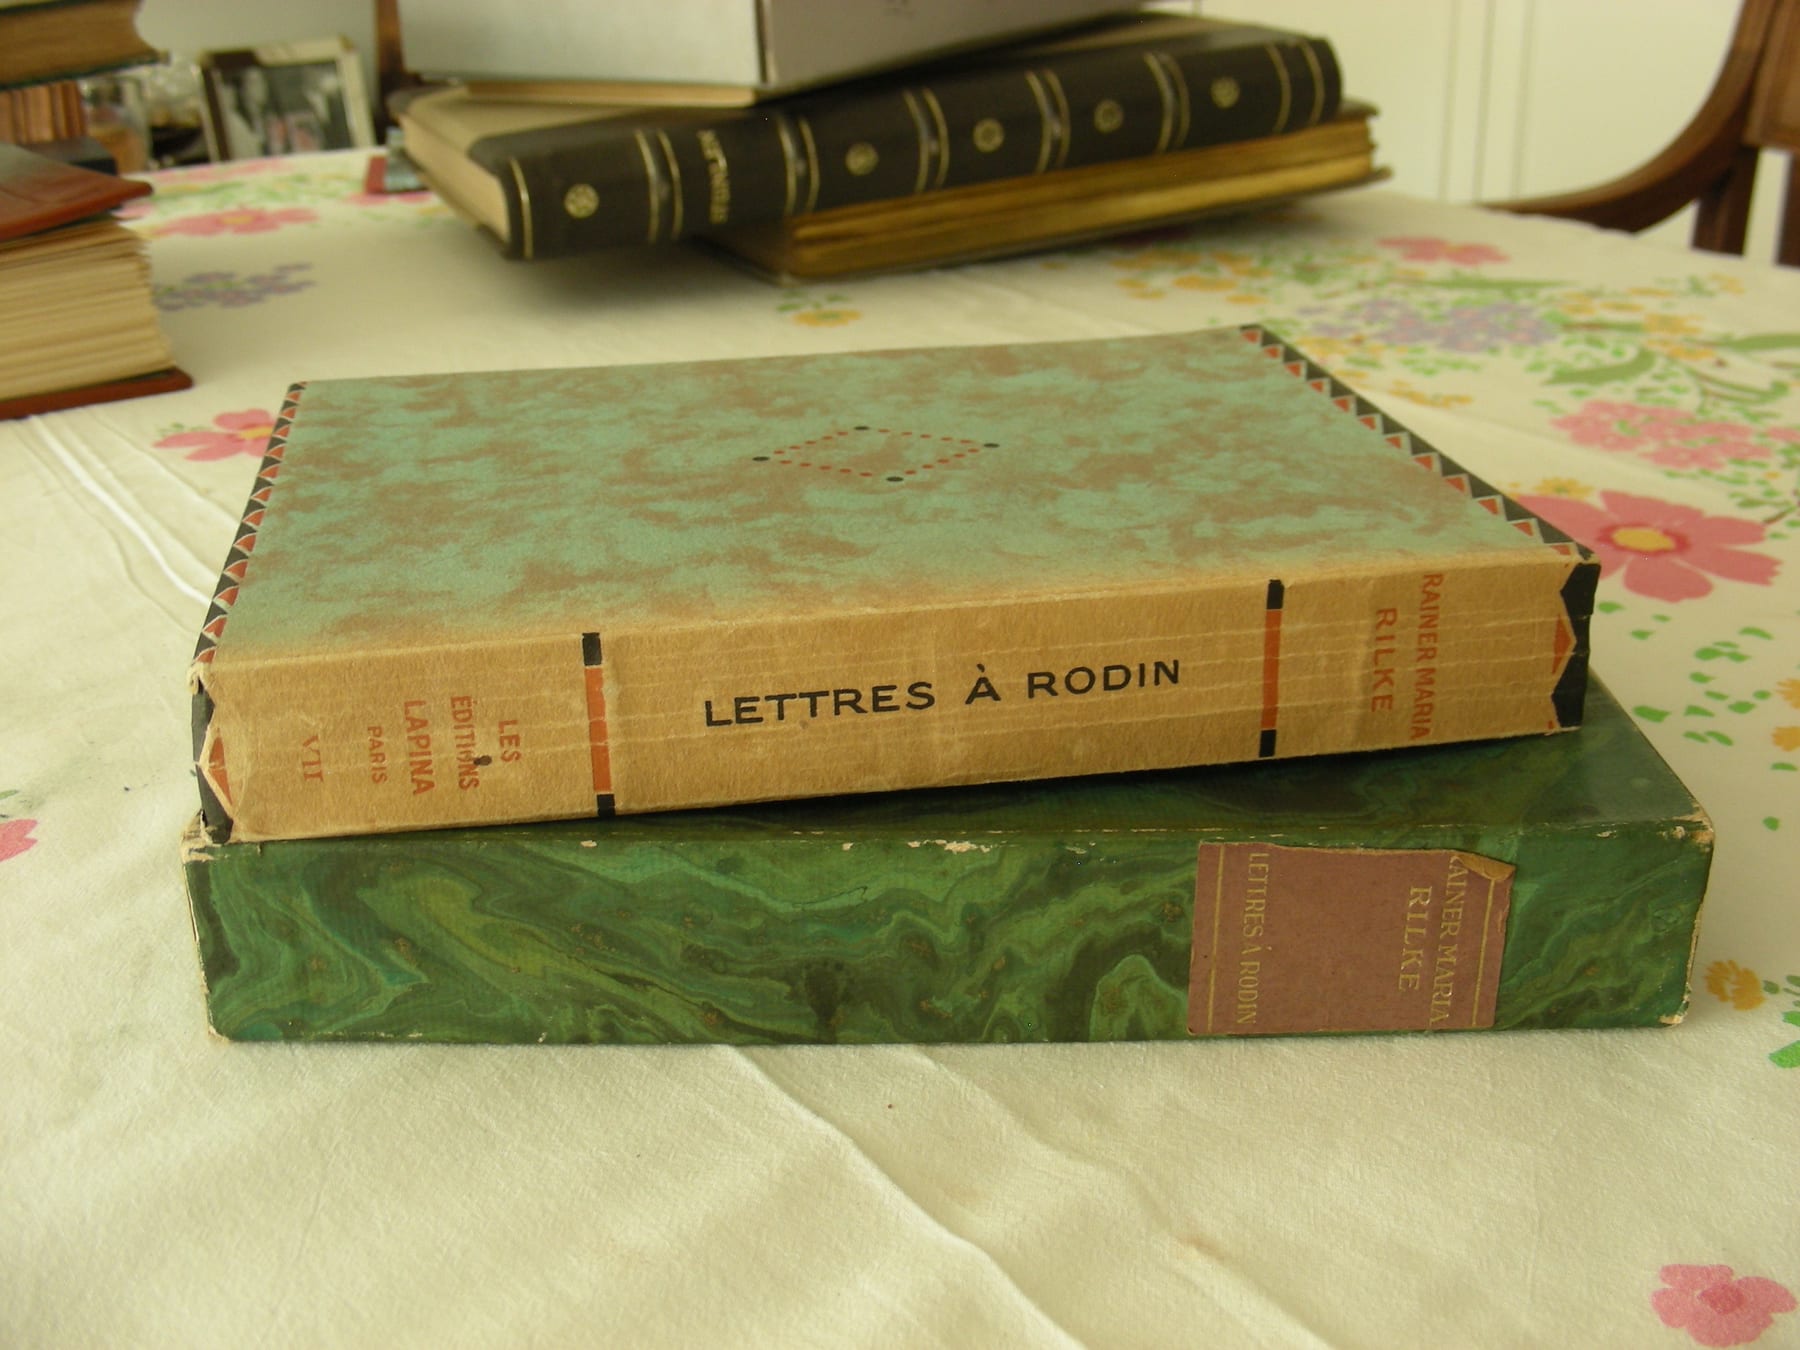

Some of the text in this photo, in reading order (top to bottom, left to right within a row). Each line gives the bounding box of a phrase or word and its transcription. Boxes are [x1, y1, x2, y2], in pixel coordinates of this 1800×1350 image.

[705, 659, 1181, 726] LETTRES À RODIN
[1371, 607, 1397, 713] RILKE
[1410, 572, 1443, 740] RAINER MARIA
[367, 725, 387, 785] PARIS
[404, 700, 435, 796] LAPINA
[498, 719, 521, 762] LES
[1242, 853, 1270, 938] LETTRES
[1399, 886, 1433, 993] RILKE
[1236, 960, 1261, 1026] RODIN
[1429, 943, 1457, 1027] MARIA
